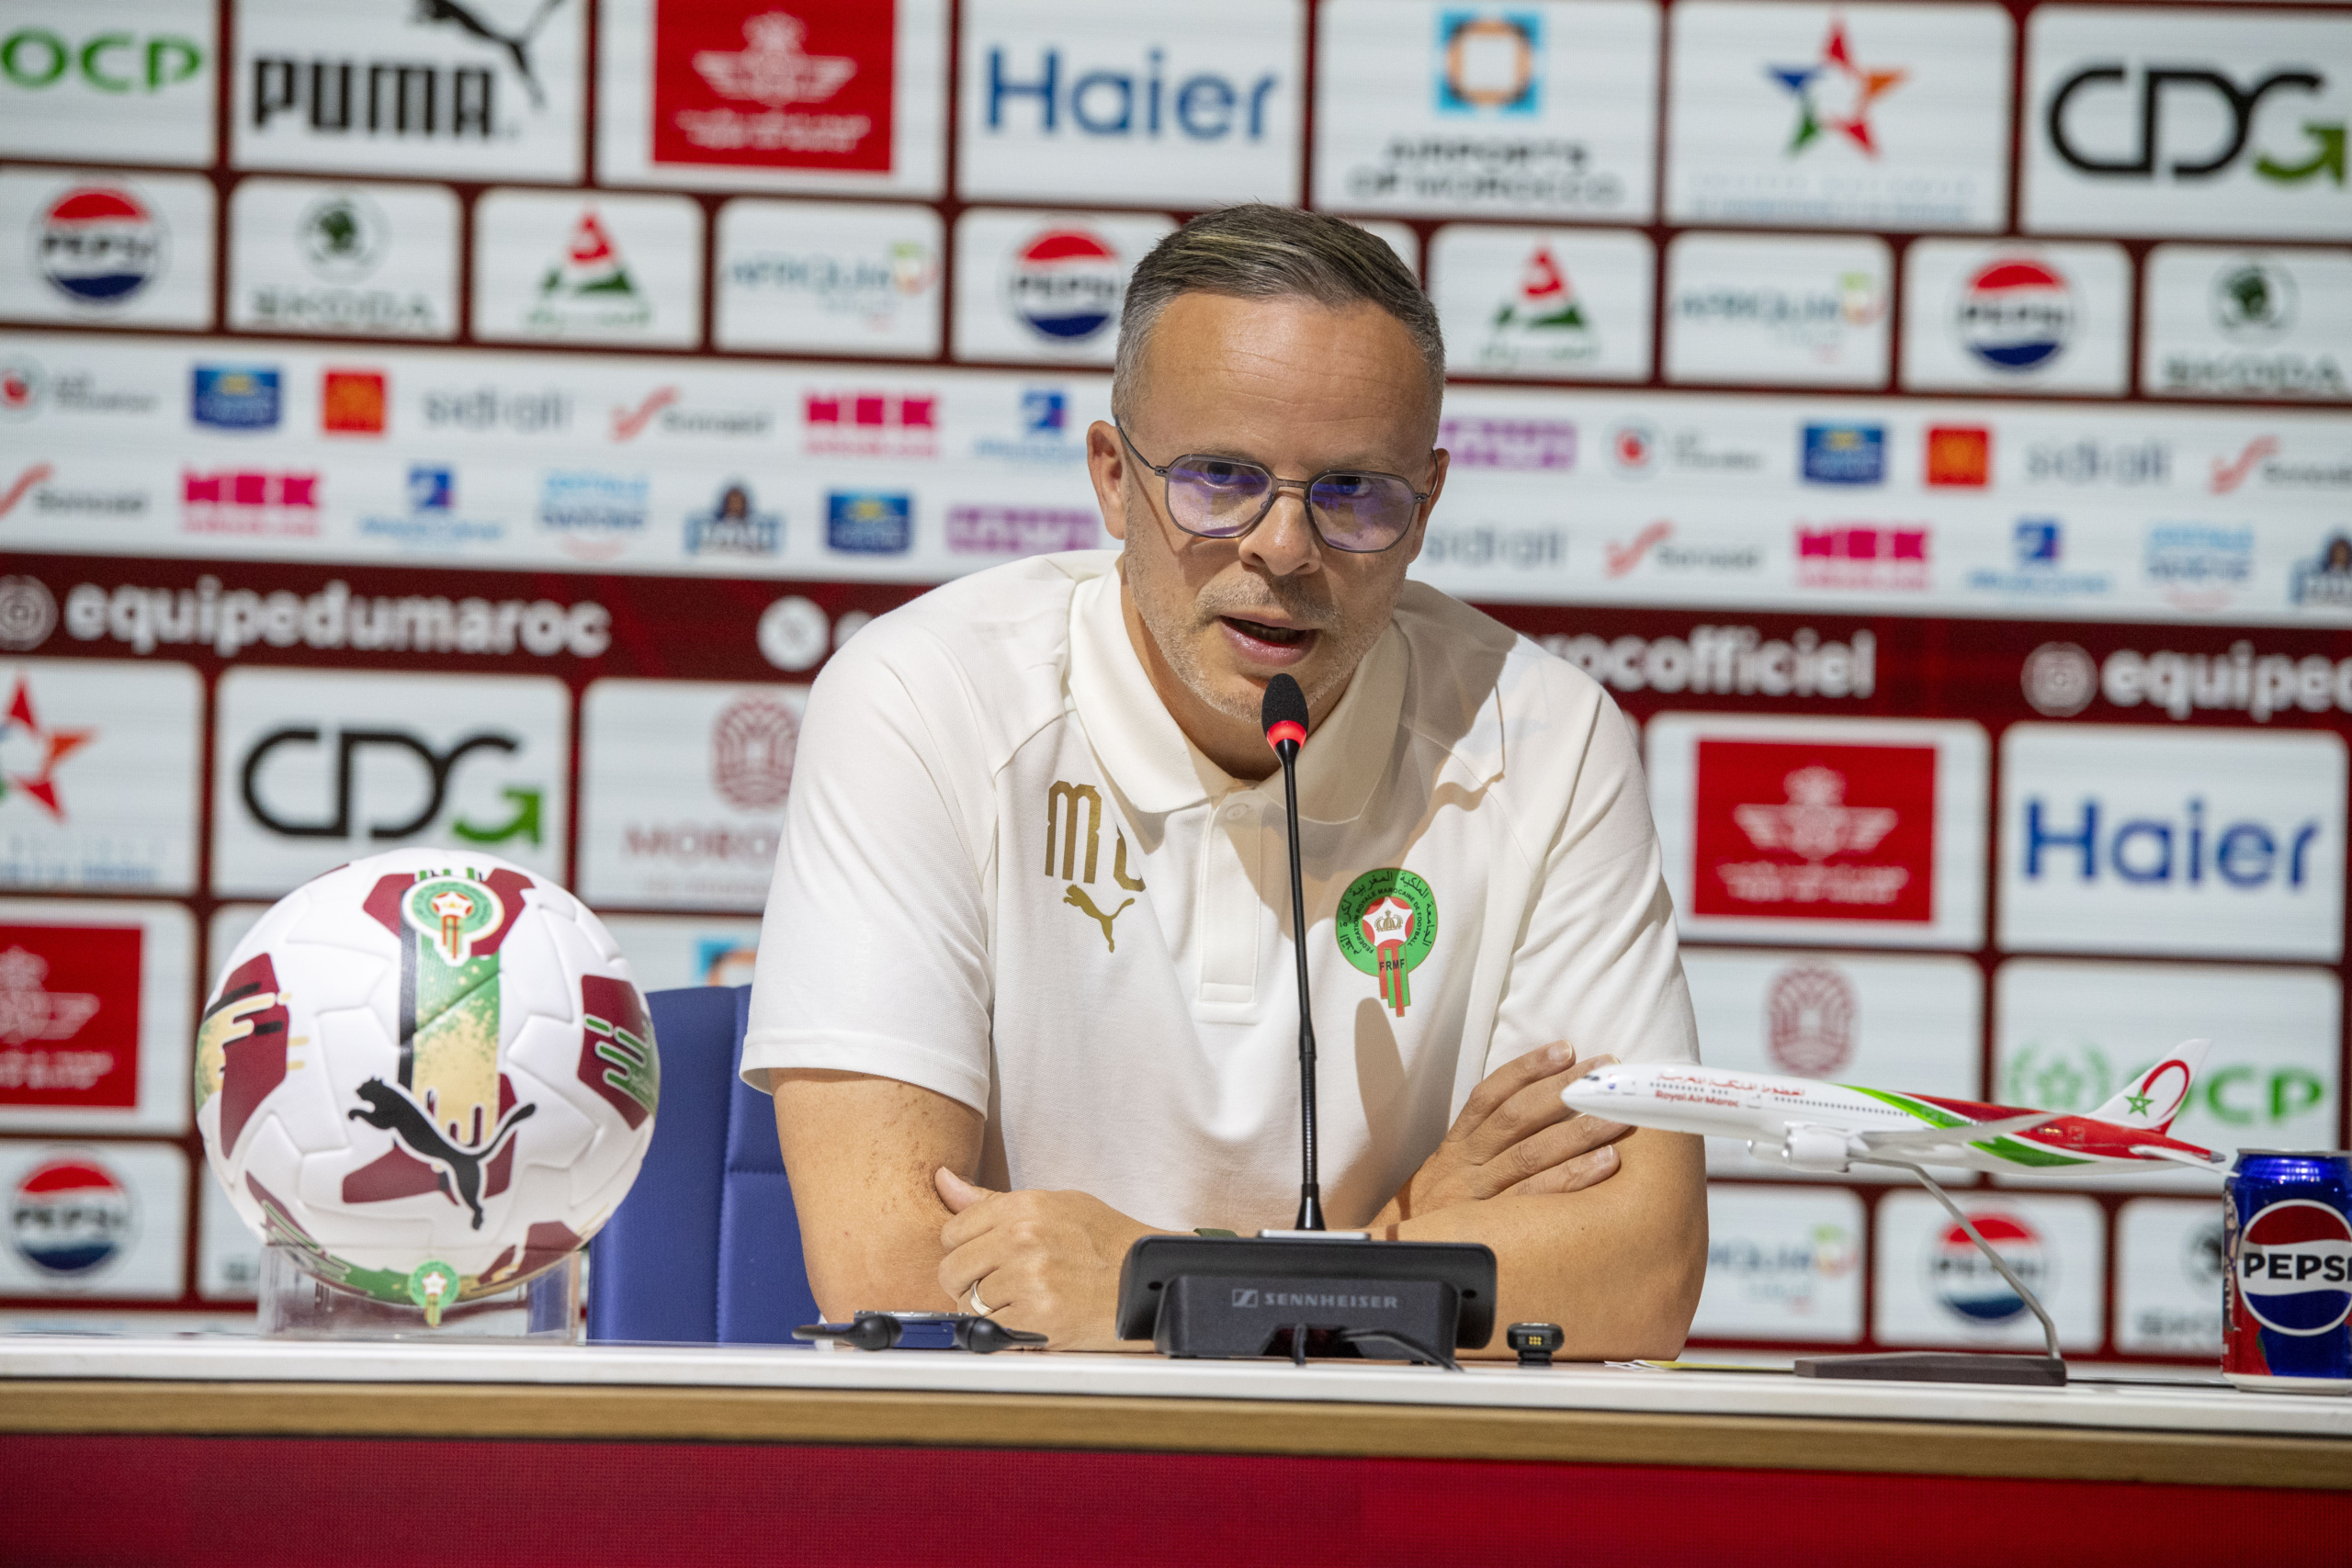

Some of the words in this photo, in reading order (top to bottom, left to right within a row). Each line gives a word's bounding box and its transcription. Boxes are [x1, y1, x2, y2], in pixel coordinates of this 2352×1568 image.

[0, 28, 203, 93] OCP
[251, 58, 496, 138] PUMA
[987, 45, 1277, 141] Haier
[2045, 64, 2347, 186] CDG
[66, 574, 611, 658] equipedumaroc
[1540, 624, 1878, 699] rocofficiel
[240, 726, 545, 846] CDG
[2024, 795, 2319, 889] Haier
[1350, 871, 1392, 898] المغربية
[1355, 890, 1376, 914] ROYALE
[1377, 887, 1415, 903] MAROCAINE
[1400, 873, 1429, 898] الملكية
[1413, 902, 1420, 911] DE
[1408, 912, 1422, 947] FOOTBALL
[1379, 958, 1405, 972] FRMF
[1655, 1089, 1687, 1102] Royal
[1688, 1092, 1703, 1102] Air
[1704, 1095, 1740, 1108] Maroc
[1265, 1292, 1399, 1310] SENNHEISER
